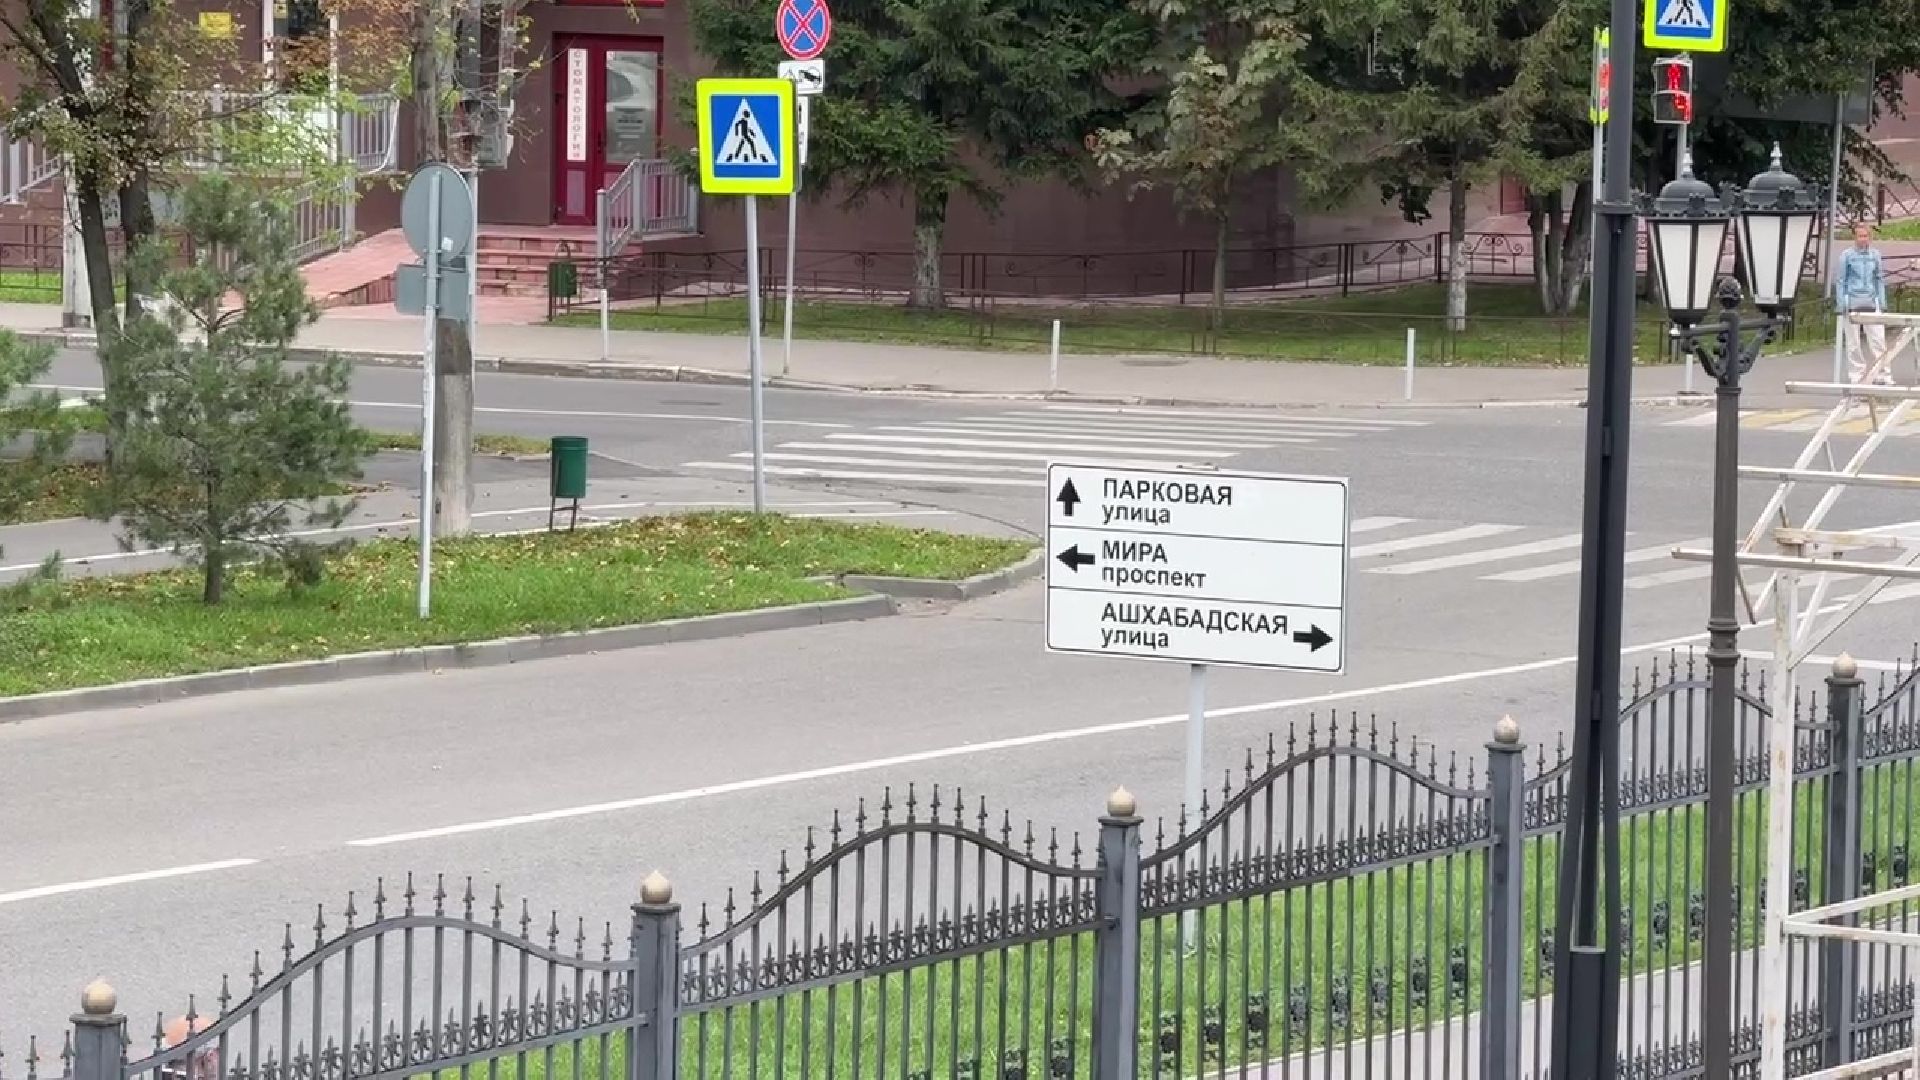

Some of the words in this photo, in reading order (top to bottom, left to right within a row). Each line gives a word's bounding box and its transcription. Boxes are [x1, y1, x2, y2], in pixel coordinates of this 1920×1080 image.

[1103, 478, 1232, 506] ПАРКОВАЯ
[1102, 504, 1170, 525] улица
[1102, 540, 1168, 563] МИРА
[1102, 566, 1207, 588] проспект
[1101, 602, 1288, 635] АШХАБАДСКАЯ
[1101, 627, 1168, 649] улица
